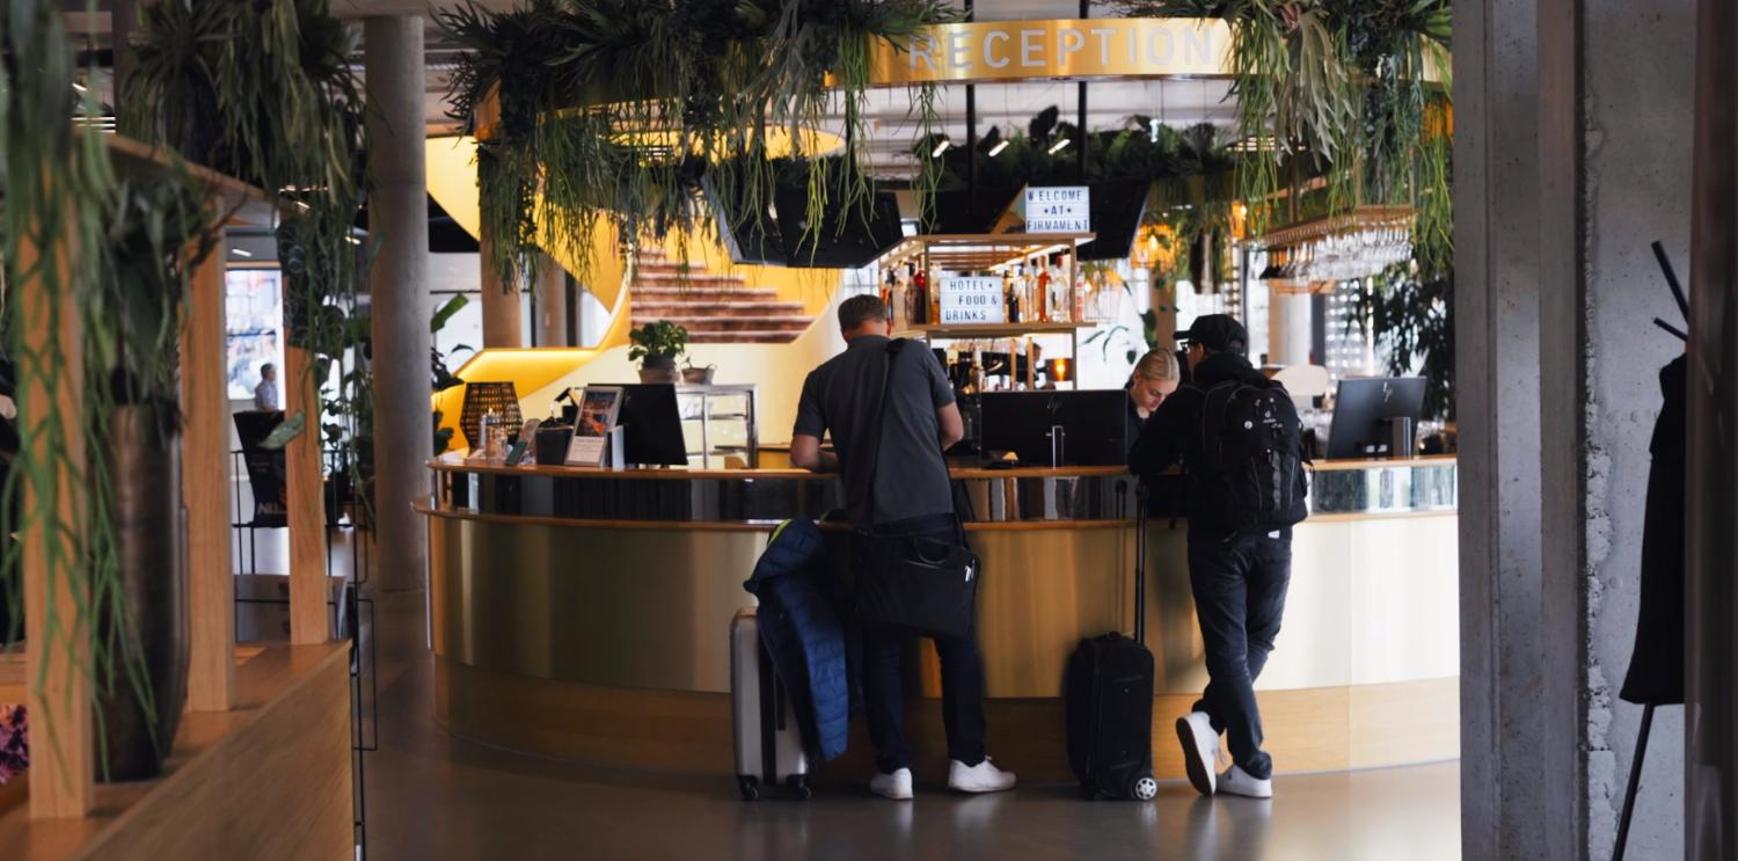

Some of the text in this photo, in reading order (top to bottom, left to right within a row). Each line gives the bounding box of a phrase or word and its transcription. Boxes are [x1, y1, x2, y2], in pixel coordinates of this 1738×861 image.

[907, 27, 1212, 71] RECEPTION
[1028, 190, 1083, 201] WELCOME
[1026, 220, 1088, 231] FIRMAMENT
[950, 280, 986, 291] HOTEL
[958, 295, 987, 306] FOOD
[945, 310, 987, 321] DRINKS
